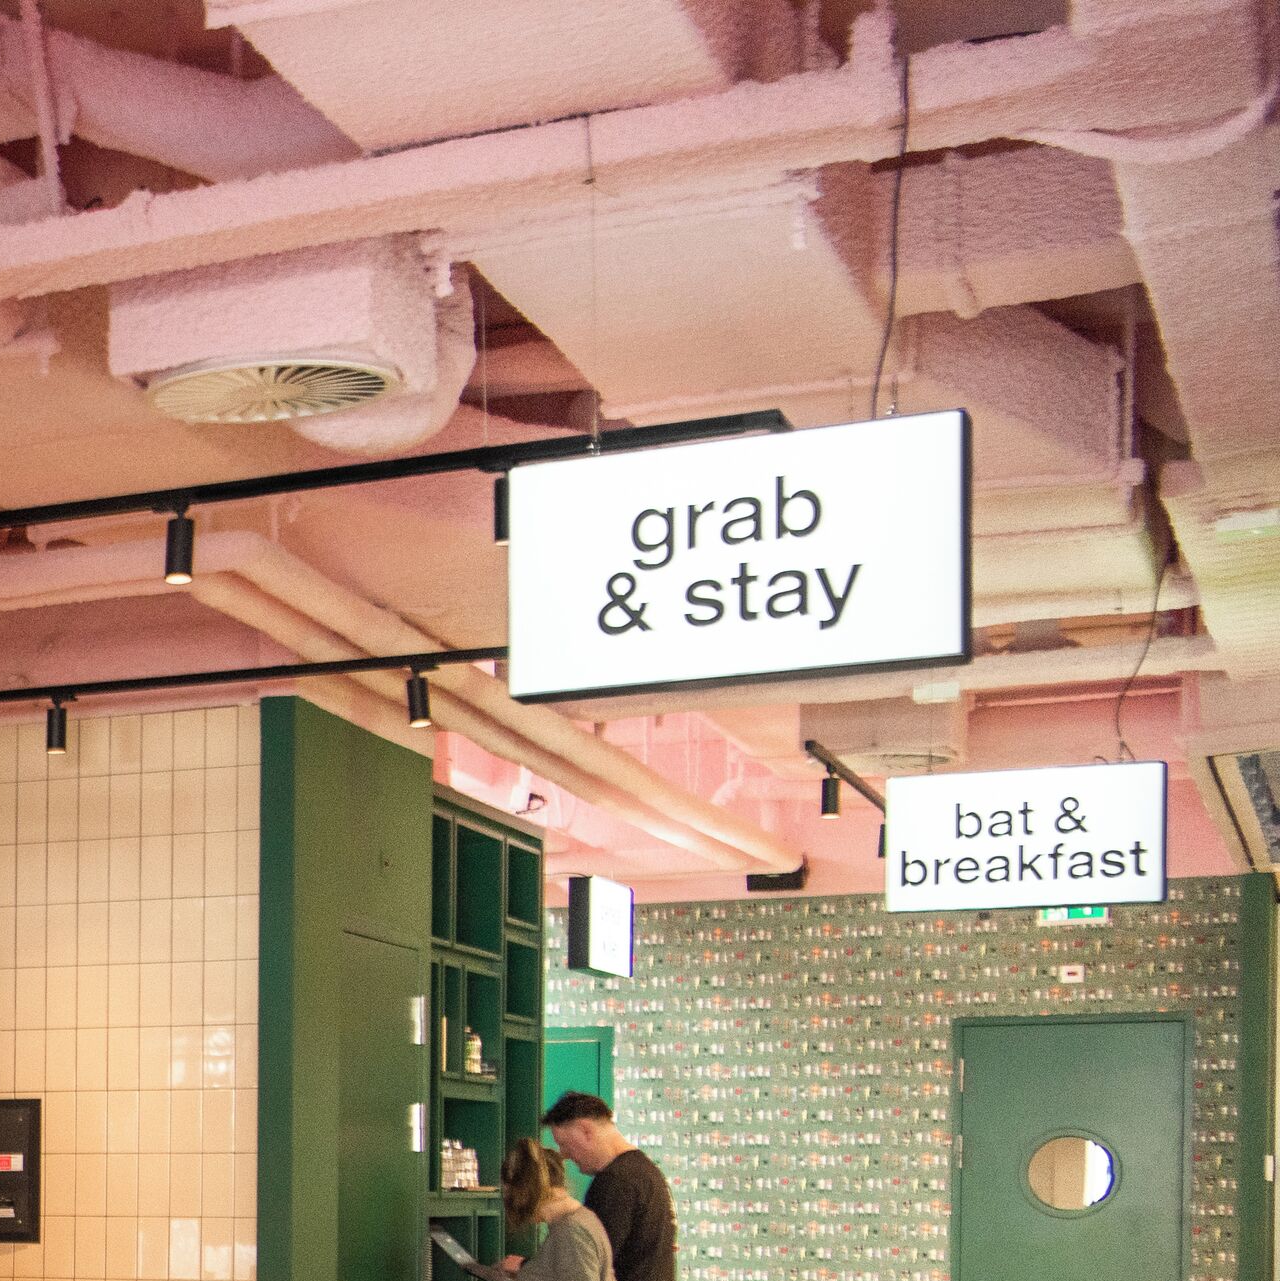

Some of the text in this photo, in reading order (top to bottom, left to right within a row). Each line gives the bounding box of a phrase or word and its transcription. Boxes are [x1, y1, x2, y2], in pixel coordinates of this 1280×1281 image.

[630, 475, 822, 571] grab
[597, 562, 864, 637] & stay
[955, 796, 1088, 839] bat &
[900, 840, 1148, 887] breakfast
